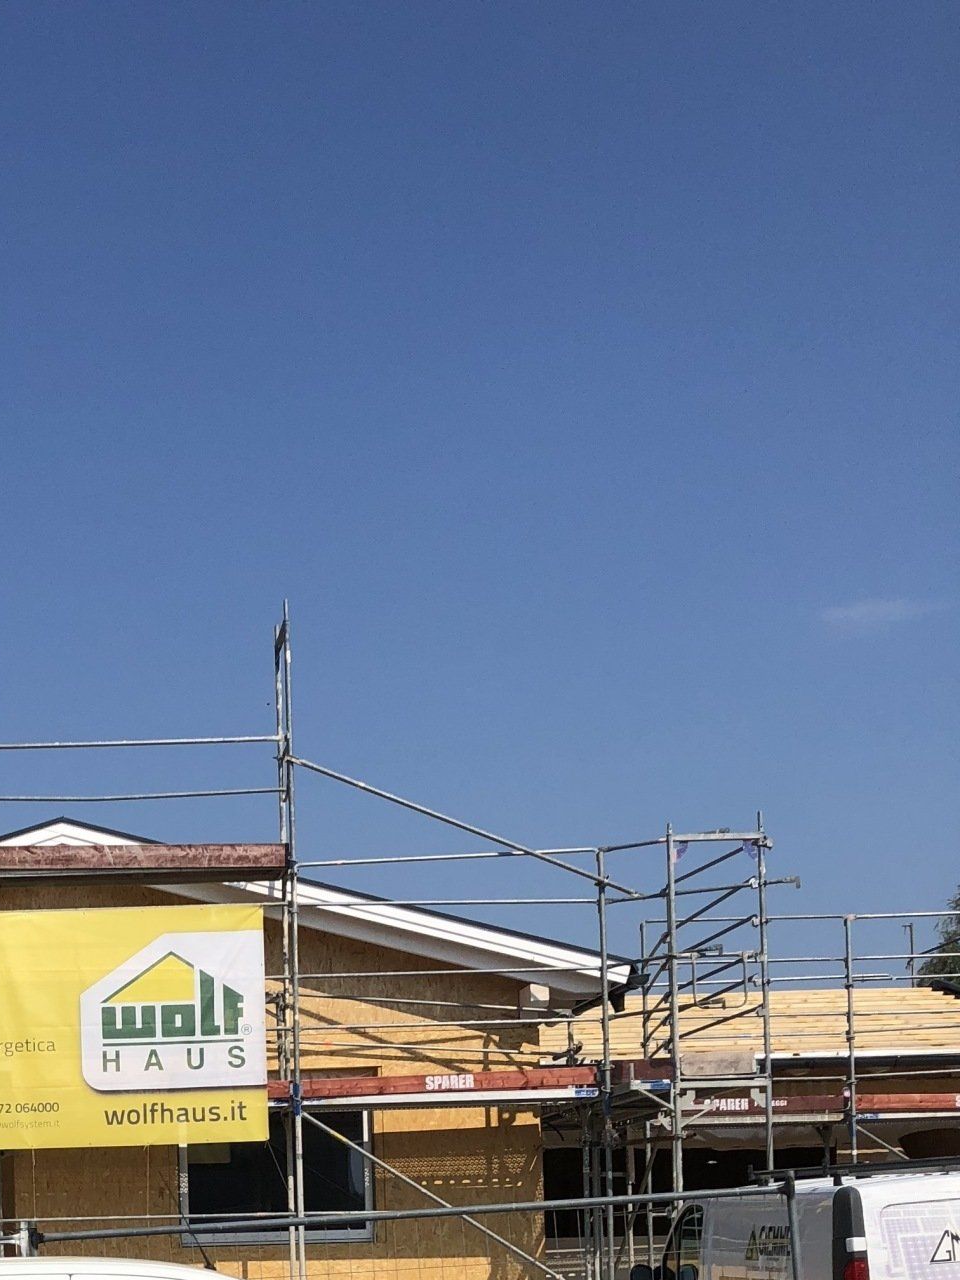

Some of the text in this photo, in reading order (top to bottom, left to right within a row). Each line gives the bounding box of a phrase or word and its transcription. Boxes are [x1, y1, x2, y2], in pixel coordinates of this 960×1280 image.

[102, 1045, 246, 1072] HAUS
[425, 1074, 475, 1090] SPARER
[15, 1102, 60, 1114] 064000
[104, 1100, 248, 1126] wolfhaus.it
